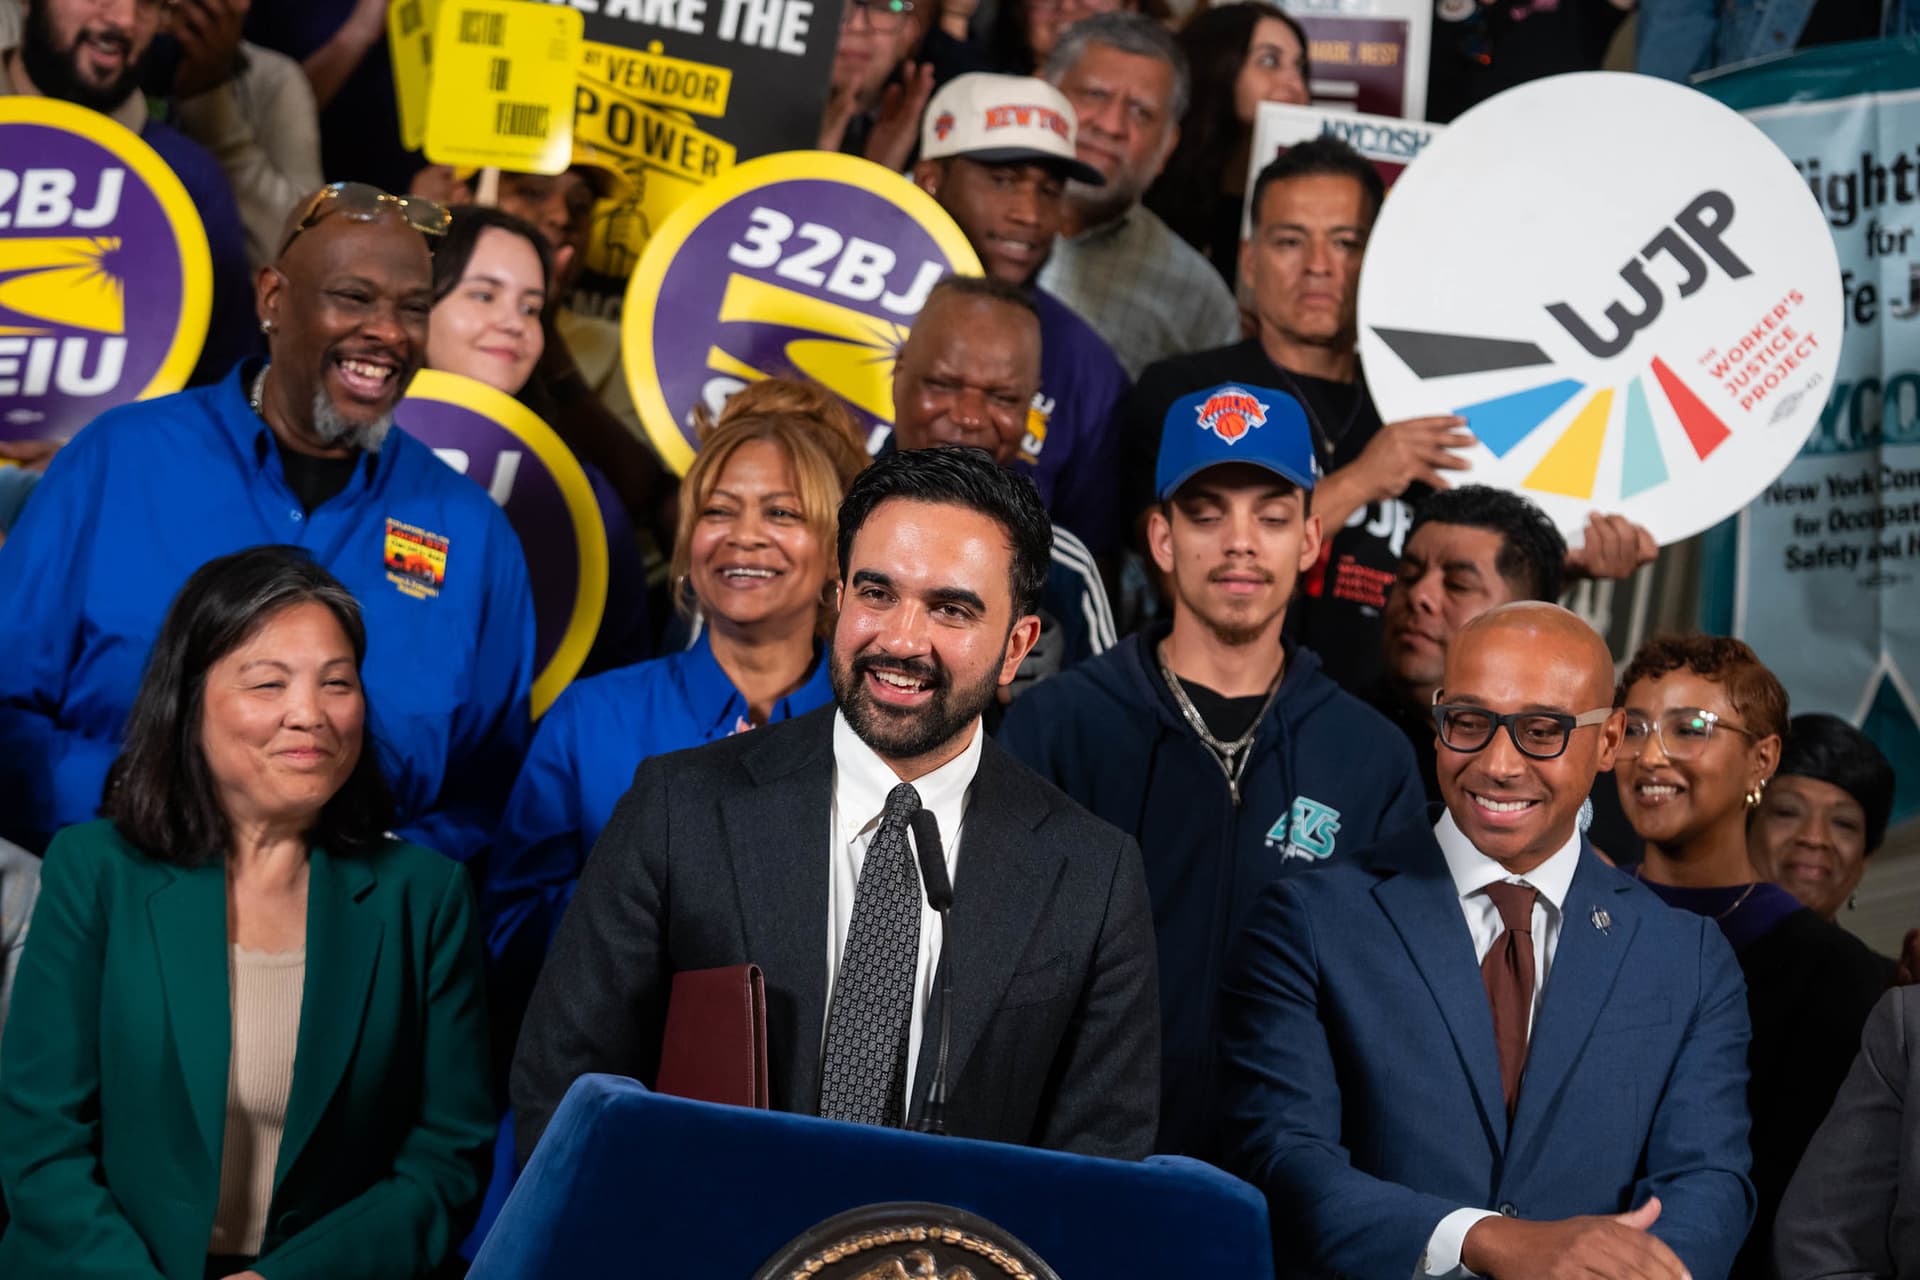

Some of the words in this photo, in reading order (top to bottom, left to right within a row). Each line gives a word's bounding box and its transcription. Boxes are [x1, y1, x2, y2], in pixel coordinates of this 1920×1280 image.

[717, 0, 813, 55] THE
[606, 55, 722, 104] VENDOR
[574, 85, 722, 177] POWER
[727, 206, 945, 316] 32BJ
[1543, 189, 1755, 359] WJP
[1866, 216, 1914, 258] for
[1709, 288, 1805, 380] WORKER'S
[1724, 324, 1799, 398] JUSTICE
[1740, 332, 1820, 413] PROJECT
